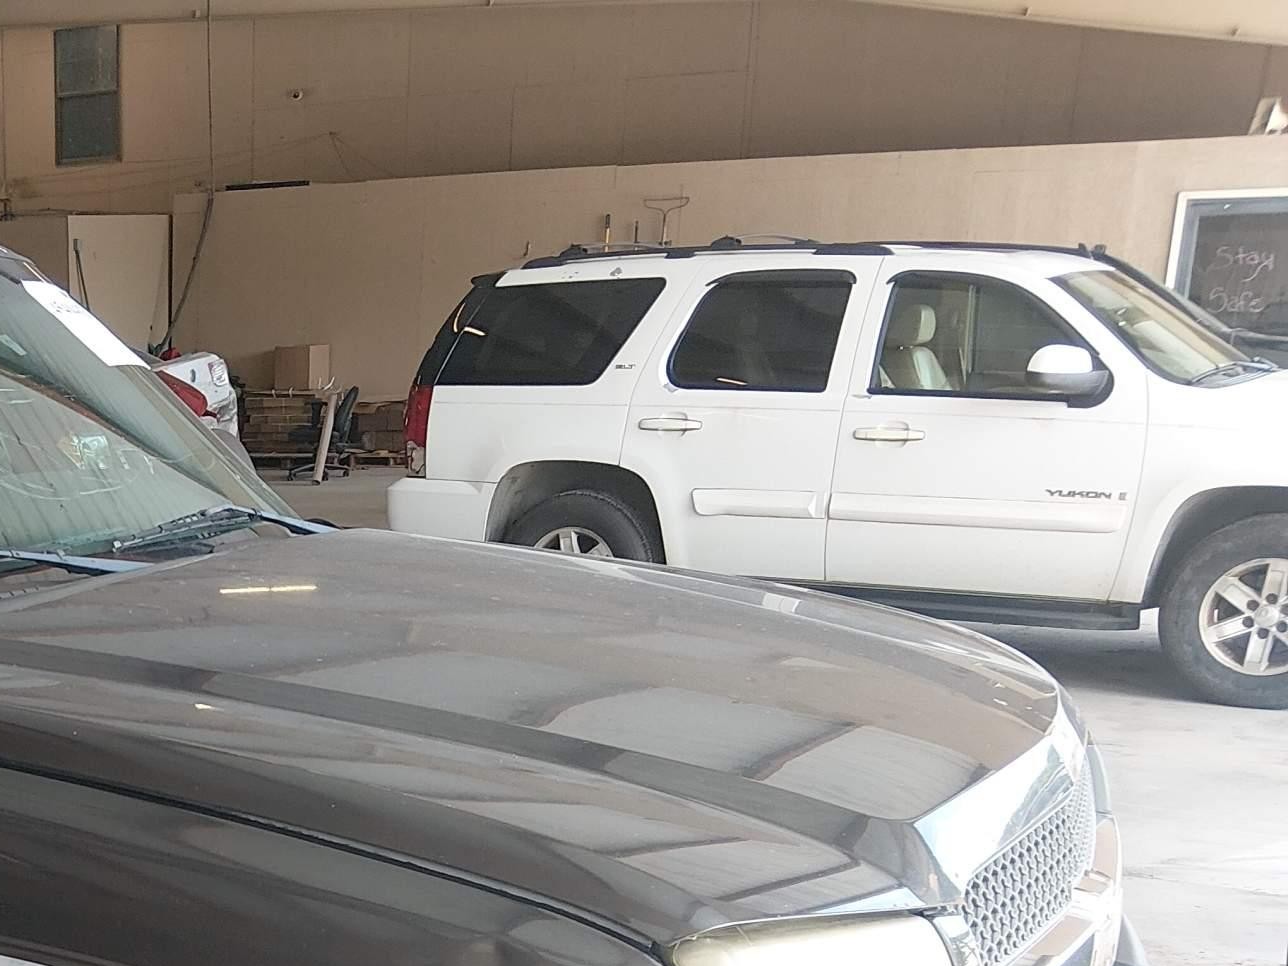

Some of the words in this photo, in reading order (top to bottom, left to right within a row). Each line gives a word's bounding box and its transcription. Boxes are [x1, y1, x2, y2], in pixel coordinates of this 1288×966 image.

[1210, 247, 1274, 282] Stay
[1208, 286, 1265, 313] Safe
[1045, 488, 1113, 500] YUKON
